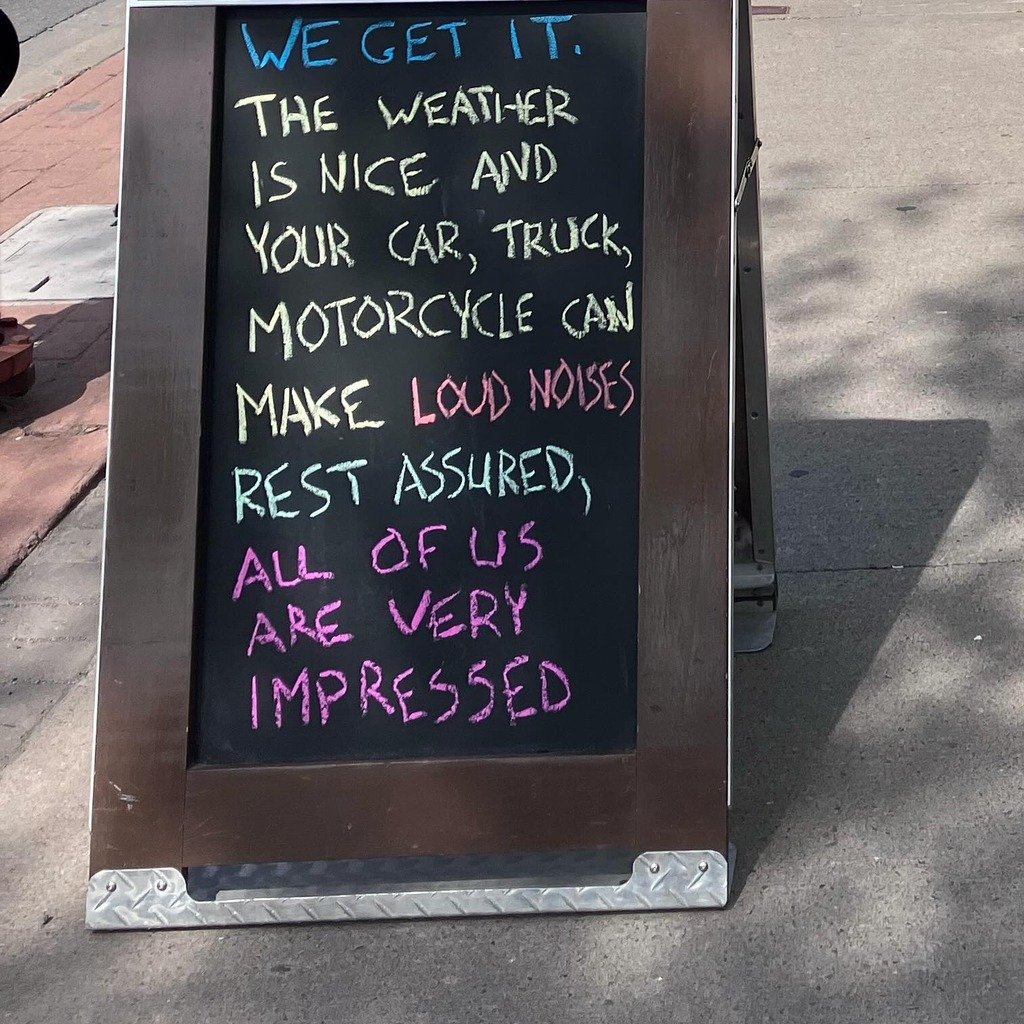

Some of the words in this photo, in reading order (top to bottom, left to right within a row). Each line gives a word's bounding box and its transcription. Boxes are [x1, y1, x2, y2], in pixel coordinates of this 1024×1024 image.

[241, 18, 341, 71] WE
[361, 19, 466, 64] GET
[509, 14, 582, 61] IT.
[233, 93, 339, 138] THE
[377, 84, 580, 131] WEATHER
[250, 159, 299, 209] IS
[320, 150, 440, 197] NICE
[471, 141, 558, 194] AND
[245, 220, 356, 276] YOUR
[388, 219, 479, 275] CAR,
[491, 212, 633, 268] TRUCK,
[248, 288, 534, 360] MOTORCYCLE
[562, 281, 635, 339] CAN
[236, 378, 384, 444] MAKE
[411, 370, 512, 427] LOUD
[529, 358, 635, 417] NOISES
[231, 458, 368, 524] REST
[393, 444, 592, 516] ASSURED,
[232, 544, 335, 602] ALL
[370, 524, 447, 574] OF
[469, 520, 543, 571] US
[247, 600, 354, 657] ARE
[388, 581, 528, 639] VERY
[250, 655, 571, 730] IMPRESSED
